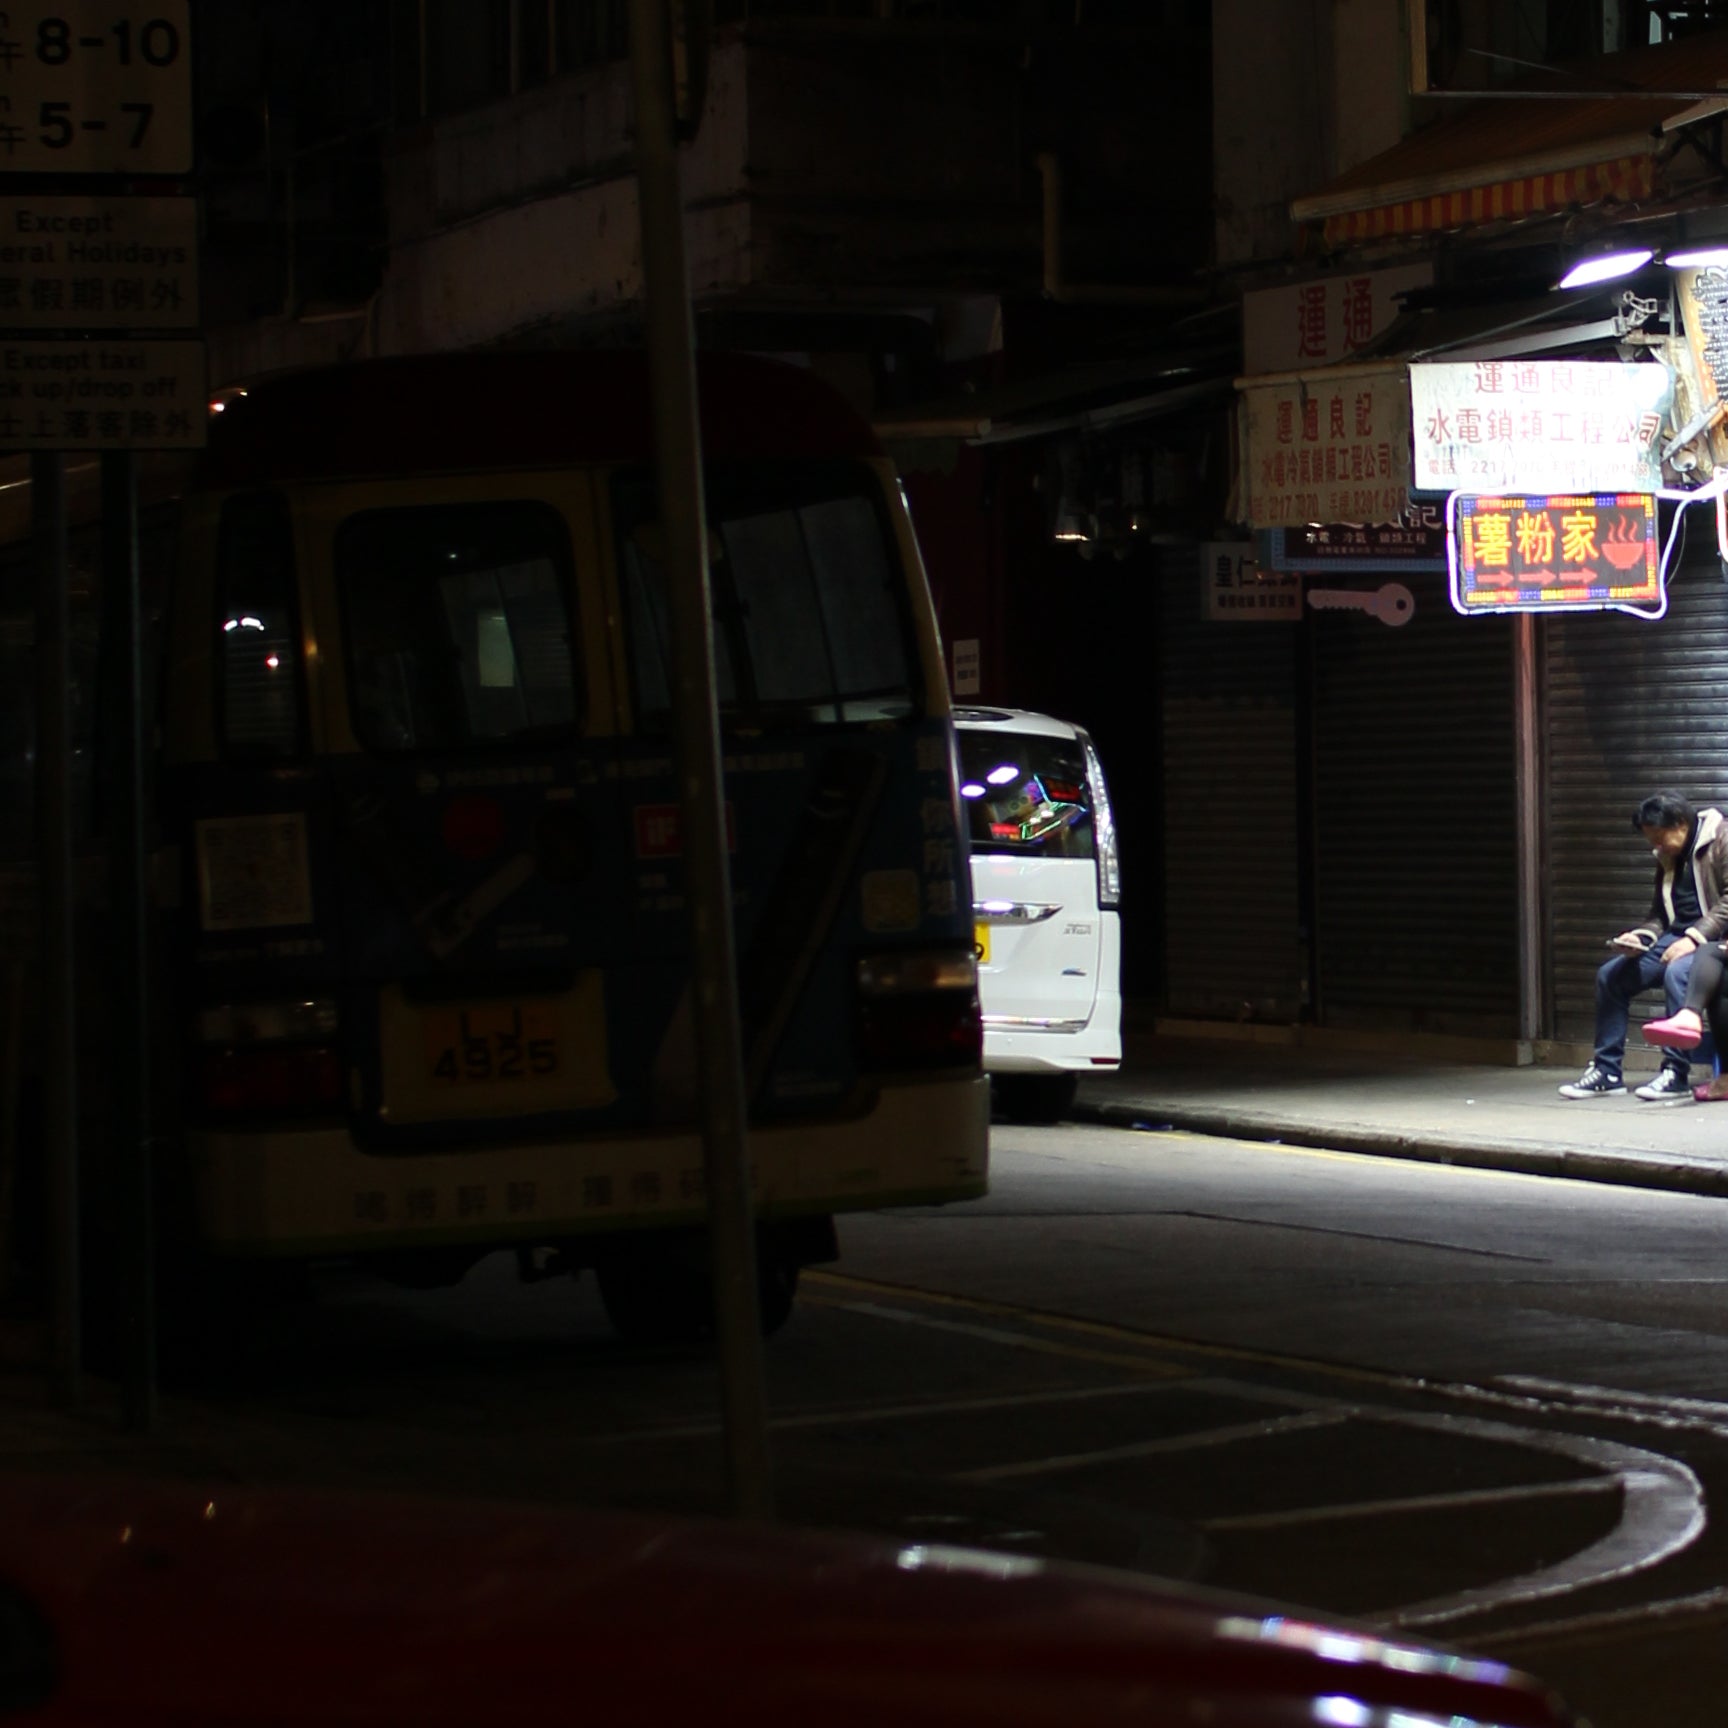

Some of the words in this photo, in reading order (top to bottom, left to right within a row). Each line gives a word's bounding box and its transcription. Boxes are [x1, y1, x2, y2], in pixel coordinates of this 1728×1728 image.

[37, 17, 180, 67] 8-10
[40, 102, 154, 150] 5-7
[16, 210, 114, 236] Except
[0, 242, 55, 263] eral
[68, 241, 187, 266] Holidays
[0, 277, 183, 312] 眾假期例外
[1297, 277, 1372, 359] 運通
[5, 349, 91, 373] Except
[100, 349, 146, 371] taxi
[141, 376, 177, 398] off
[0, 409, 191, 439] 士上落客除外
[1473, 510, 1600, 567] 薯粉家
